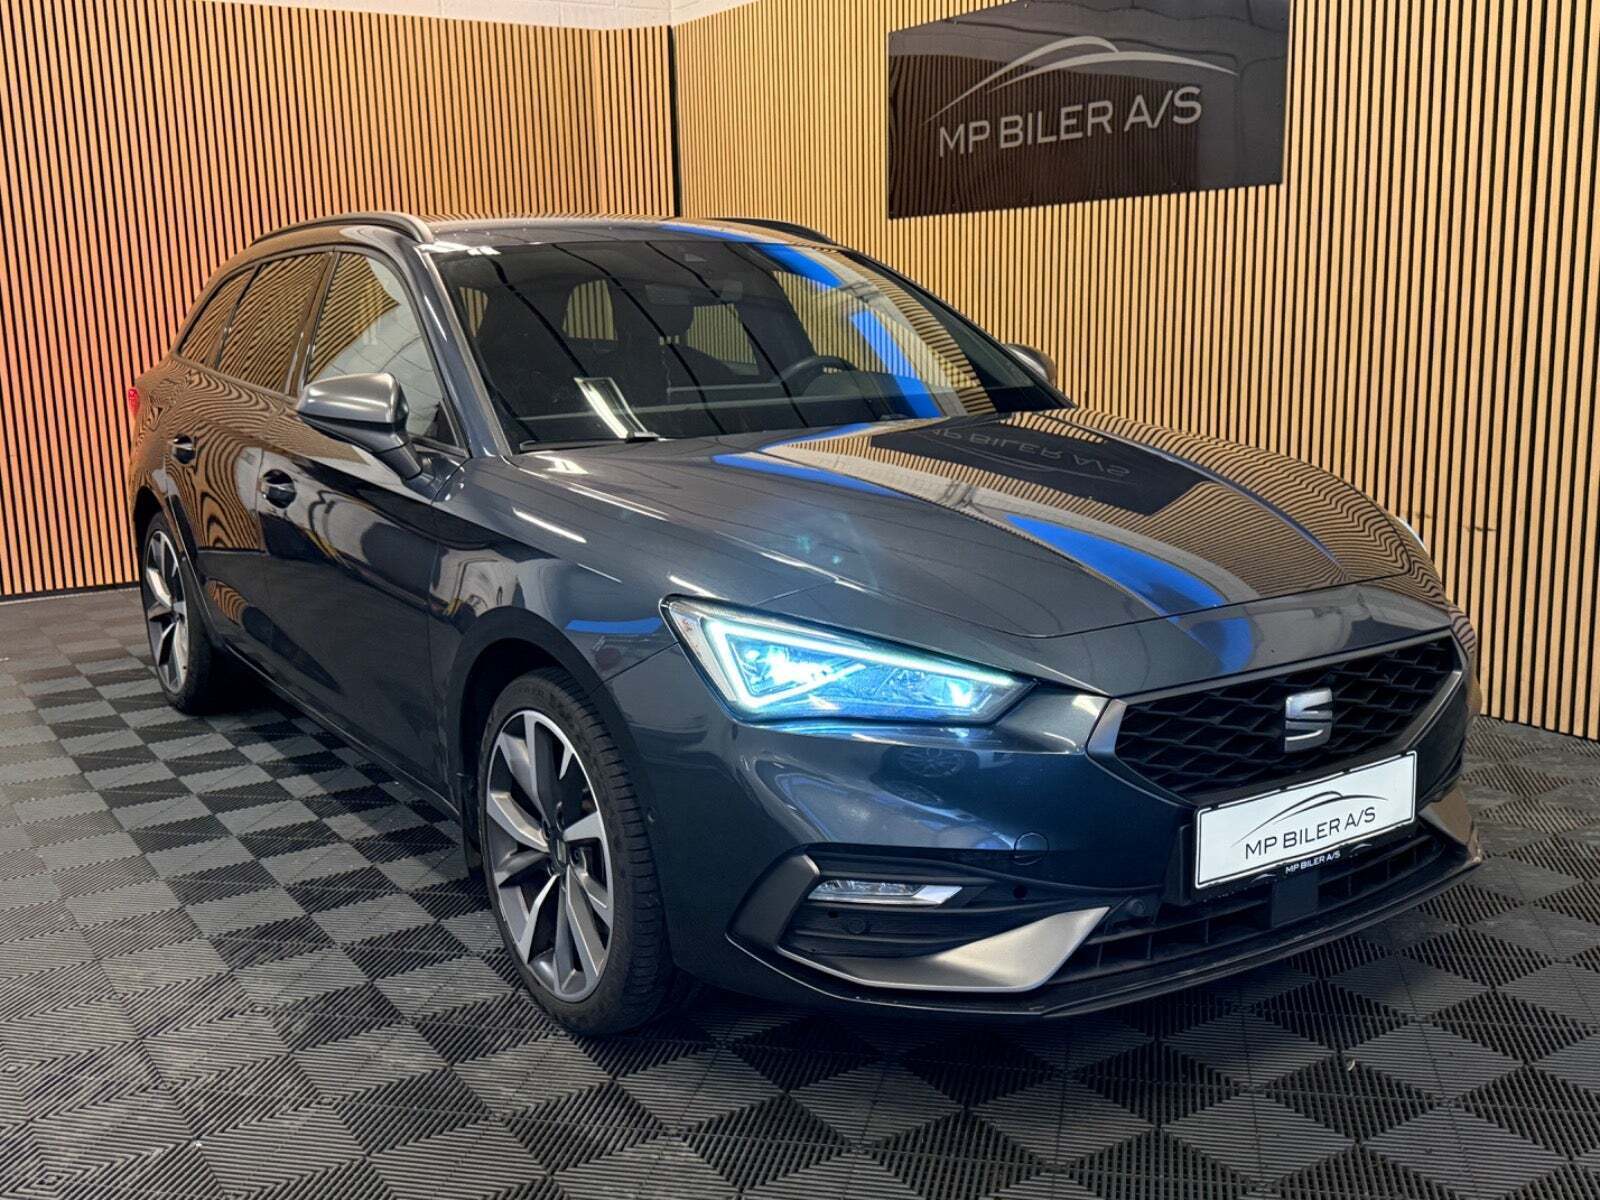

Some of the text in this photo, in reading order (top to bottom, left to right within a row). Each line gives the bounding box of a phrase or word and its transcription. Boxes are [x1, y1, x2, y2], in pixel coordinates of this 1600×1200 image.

[939, 85, 1202, 157] MP BILER A/S
[1245, 806, 1376, 859] MP BILER A/S
[1285, 850, 1340, 874] MP BILER A/S
